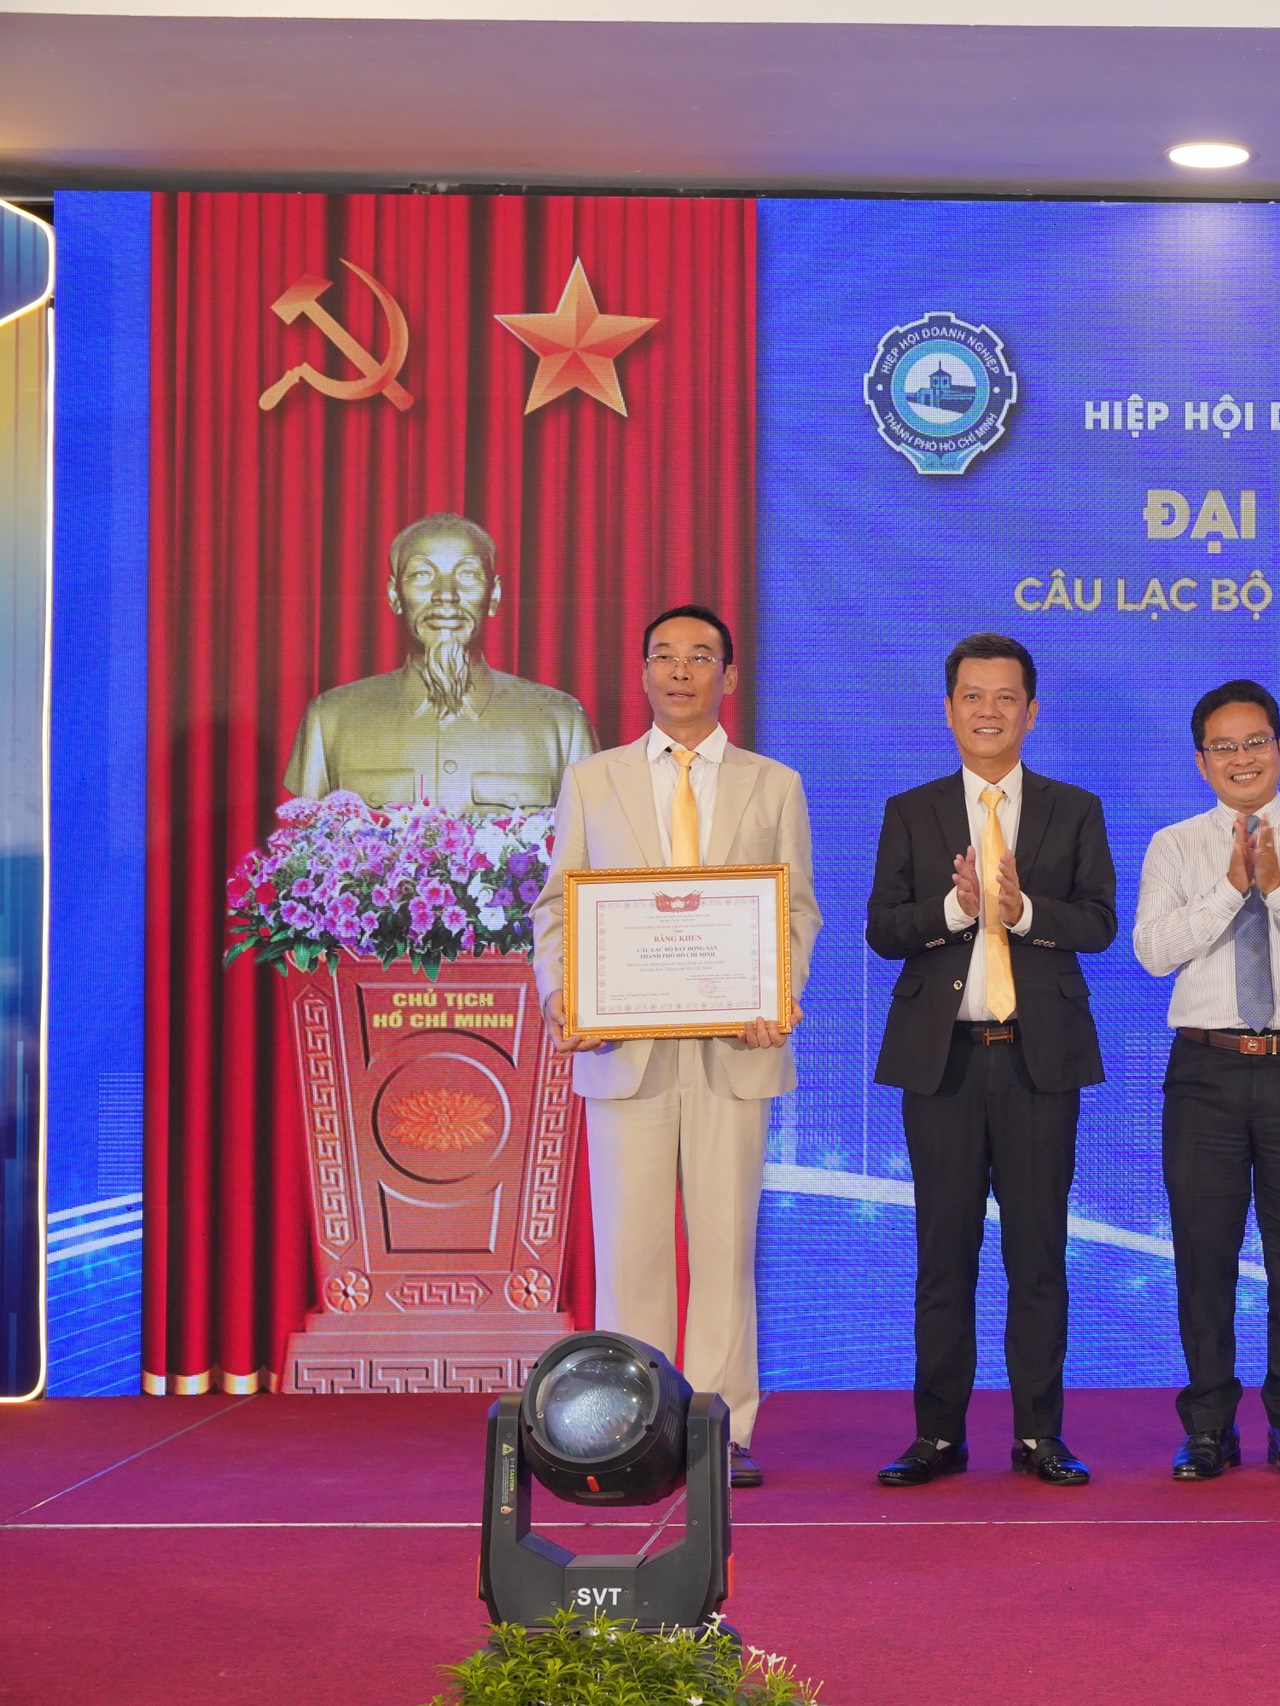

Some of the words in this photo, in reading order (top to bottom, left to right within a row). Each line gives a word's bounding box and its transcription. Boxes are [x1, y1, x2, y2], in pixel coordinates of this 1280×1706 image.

[921, 326, 966, 340] DOANH
[1085, 394, 1170, 438] HIỆP
[1184, 394, 1254, 438] HỘI
[1143, 489, 1257, 554] ĐẠI
[1013, 568, 1103, 612] CÂU
[1116, 577, 1198, 621] LẠC
[1211, 568, 1273, 621] BỘ
[679, 934, 703, 943] KHEN
[391, 987, 438, 1007] CHỦ
[445, 992, 494, 1010] TỊCH
[410, 1011, 447, 1028] CHÍ
[454, 1013, 514, 1028] MINH
[576, 1587, 622, 1606] SVT
